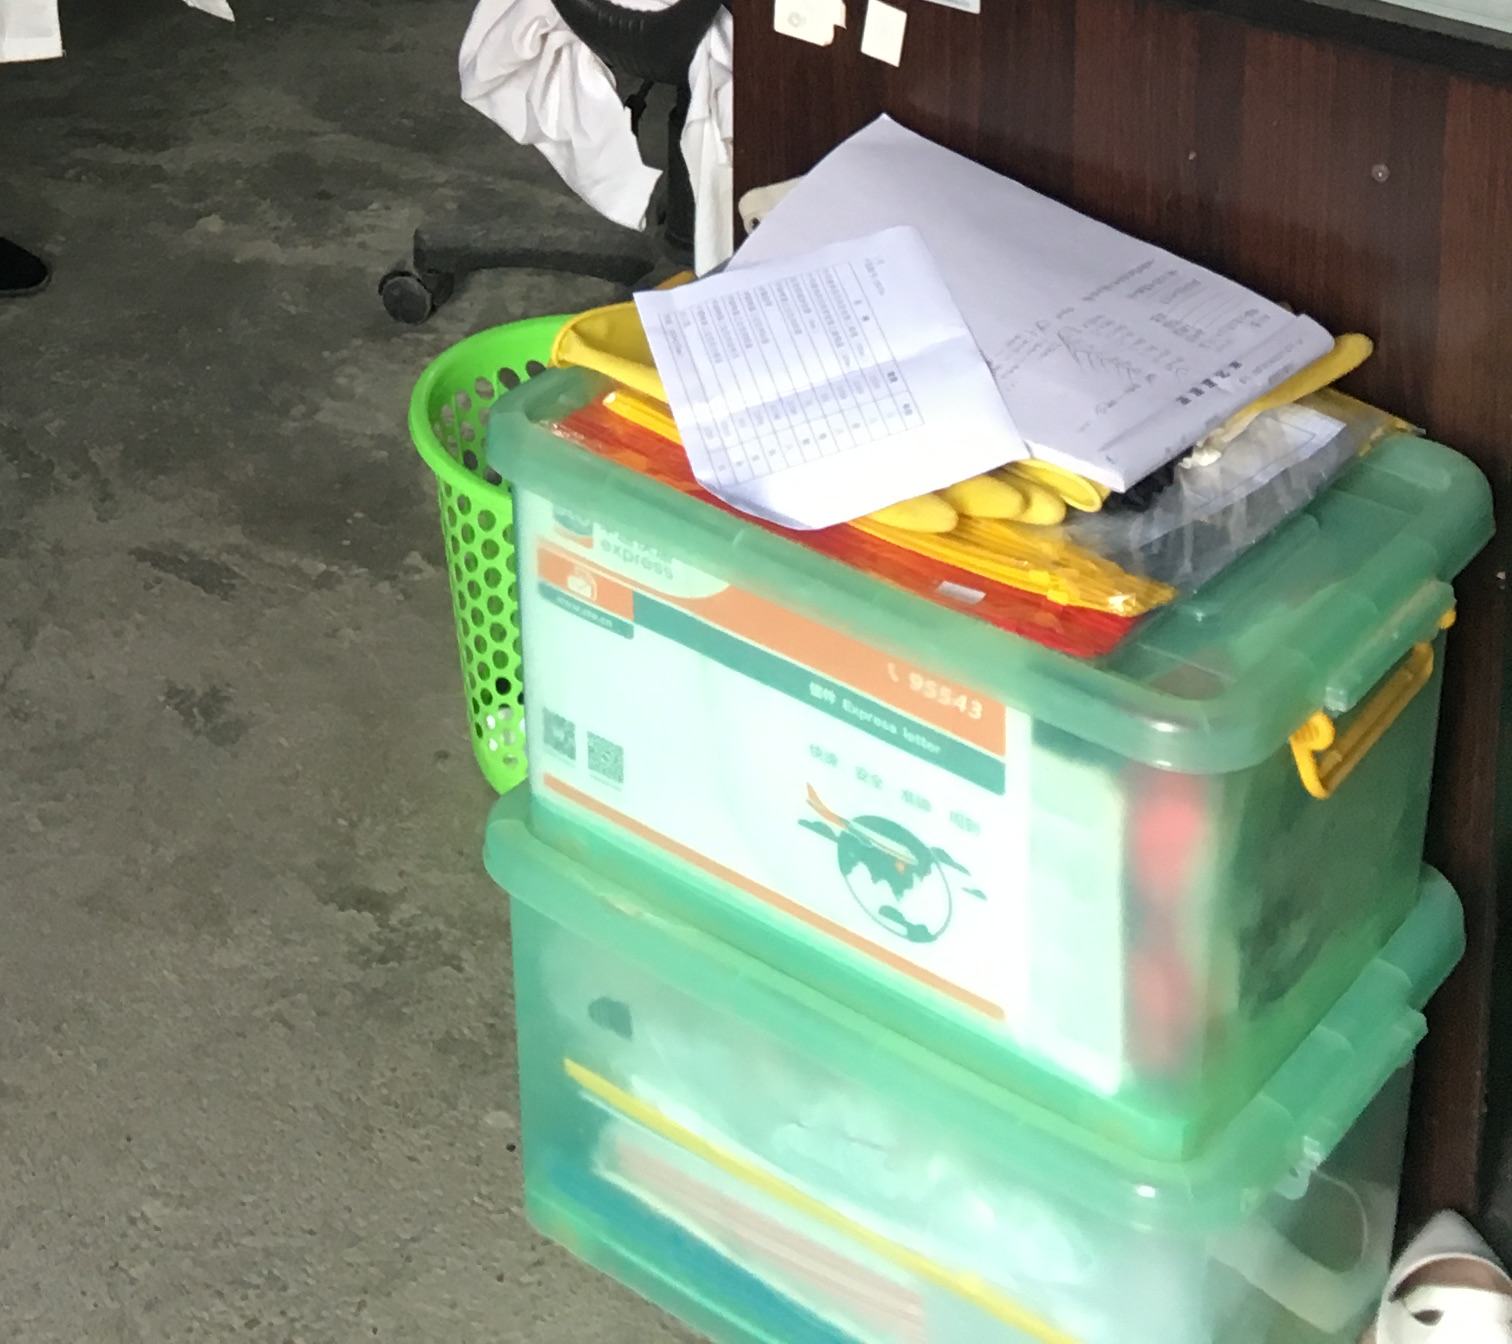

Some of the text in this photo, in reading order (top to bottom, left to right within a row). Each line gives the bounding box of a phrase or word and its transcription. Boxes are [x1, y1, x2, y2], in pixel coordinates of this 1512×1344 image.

[600, 536, 674, 581] express
[908, 671, 983, 720] 95543
[842, 698, 898, 734] Express
[902, 727, 942, 754] letter
